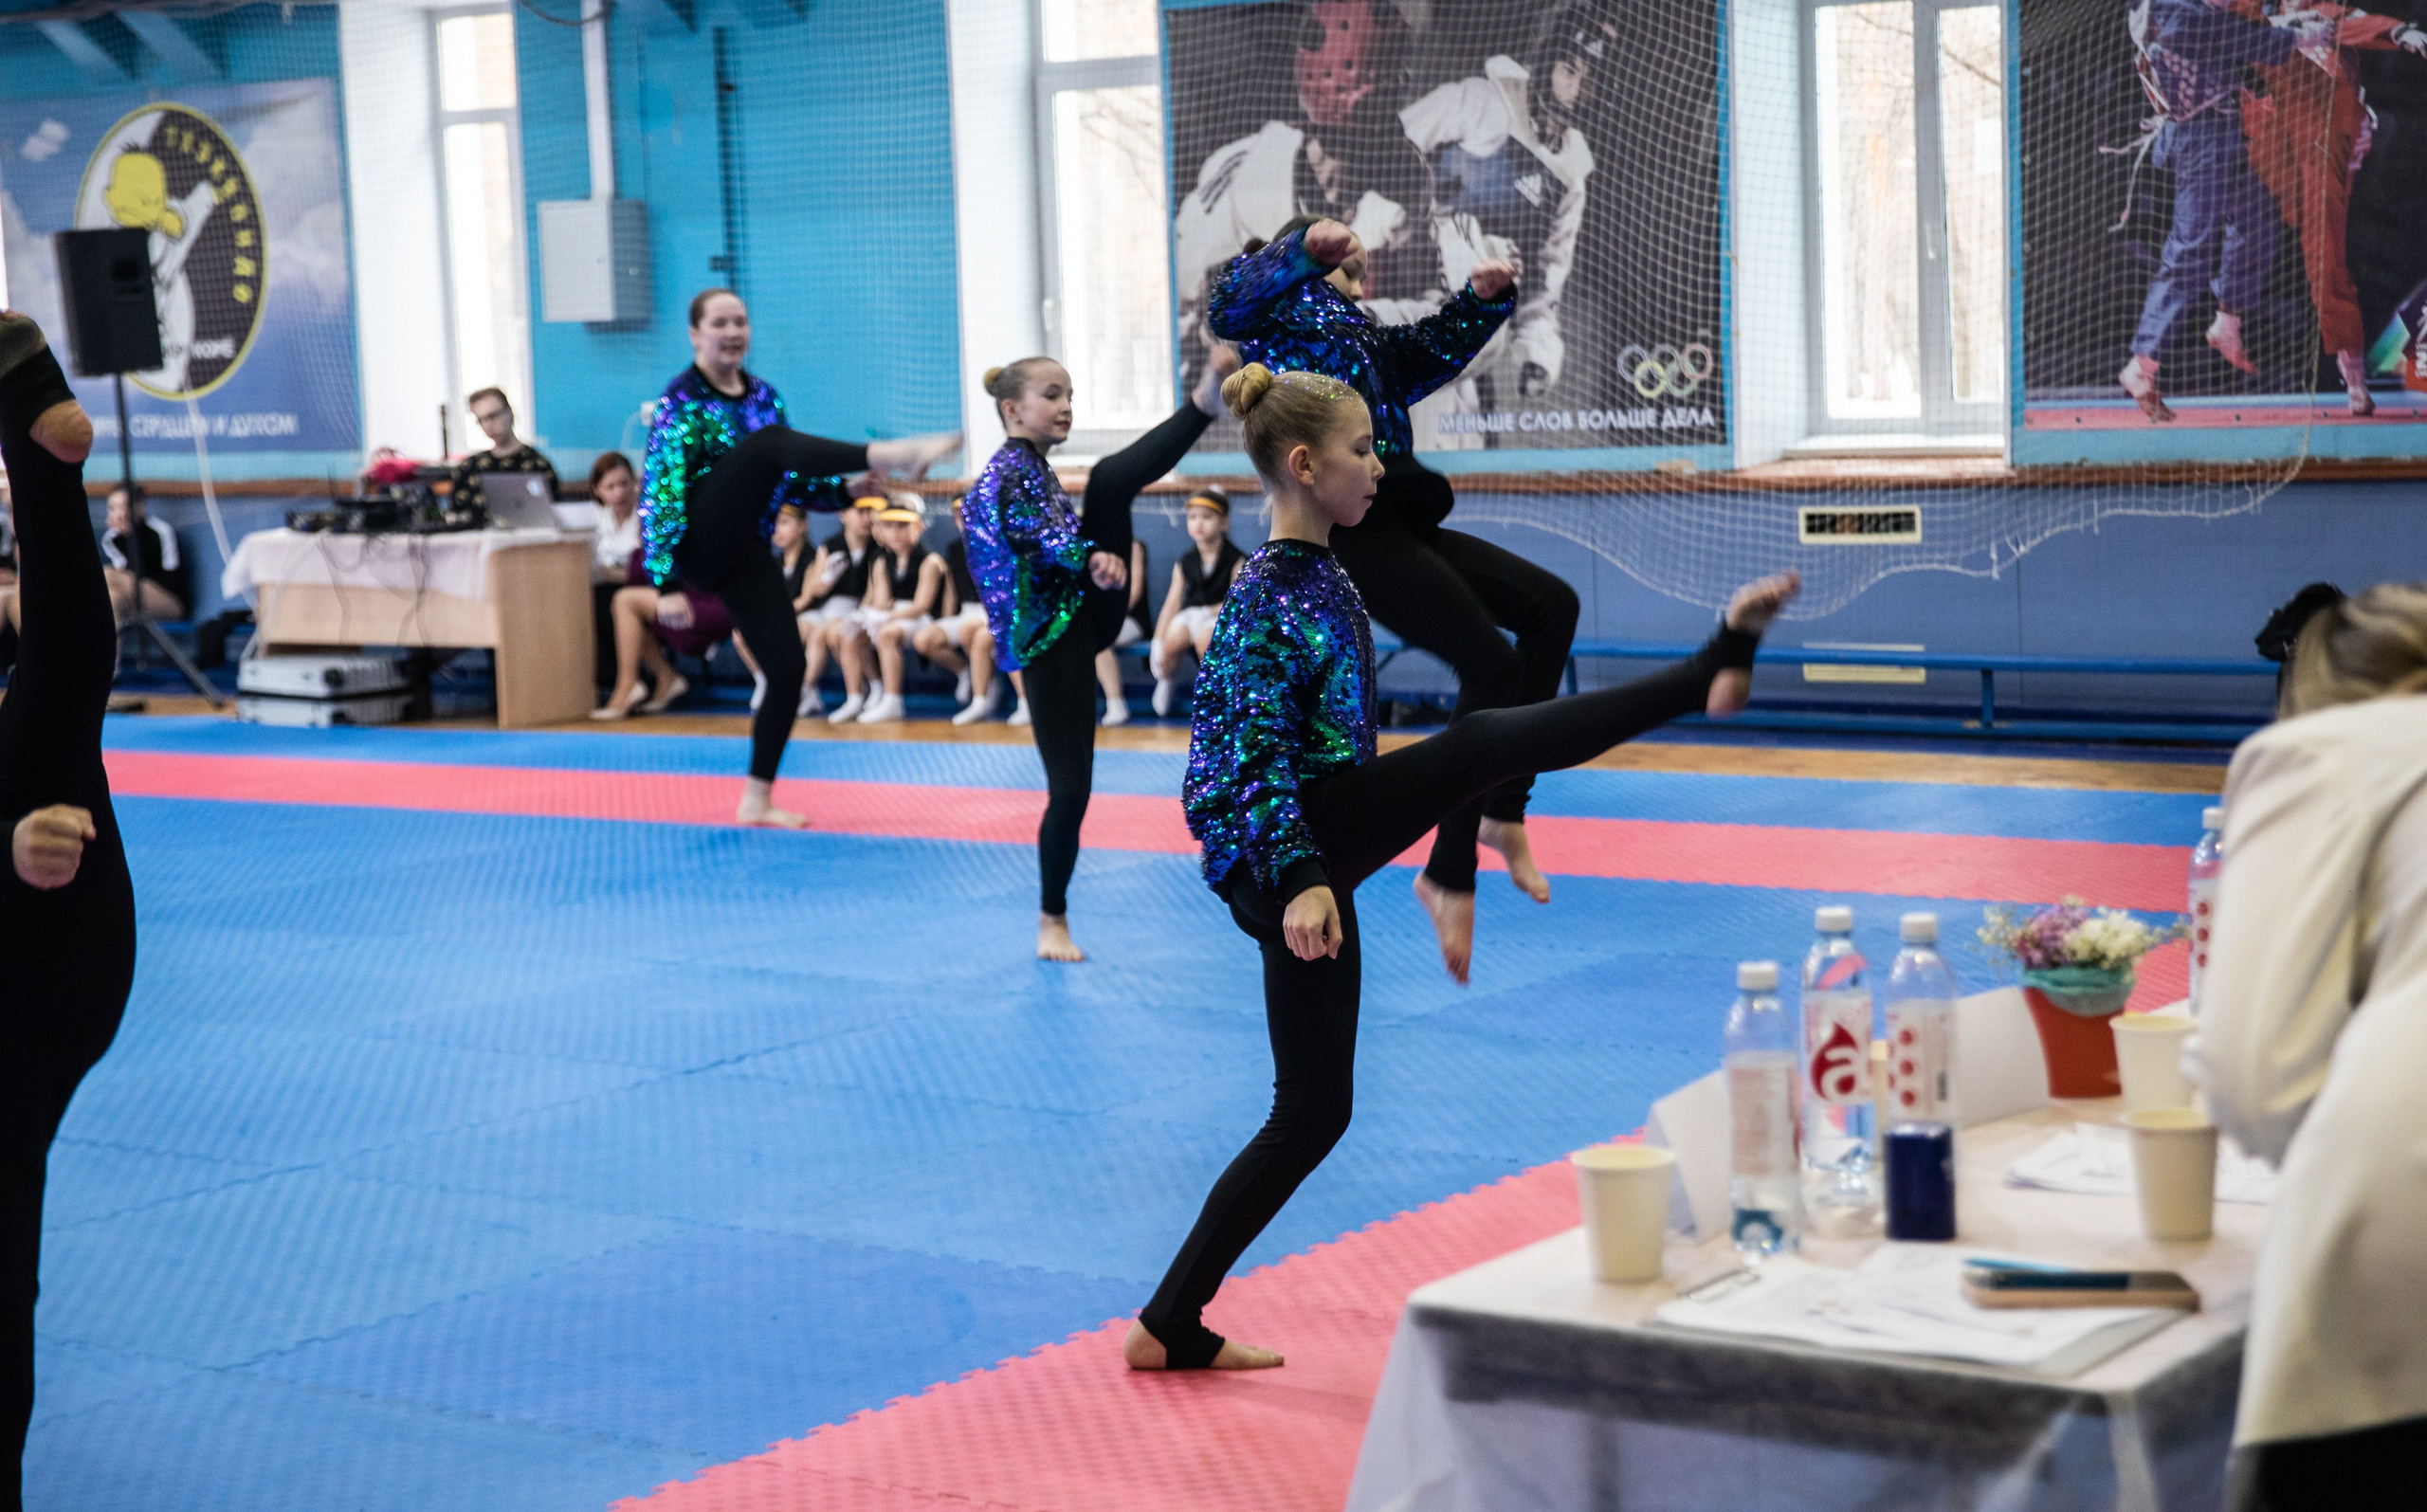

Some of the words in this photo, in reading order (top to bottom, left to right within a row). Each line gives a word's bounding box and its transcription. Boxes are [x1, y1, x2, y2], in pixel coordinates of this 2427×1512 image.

[228, 412, 299, 438] ДУХОМ
[1438, 411, 1515, 434] МЕНЬШЕ
[1519, 410, 1573, 432] СЛОВ
[1578, 409, 1657, 431] БОЛЬШЕ
[1660, 407, 1715, 429] ДЕЛА
